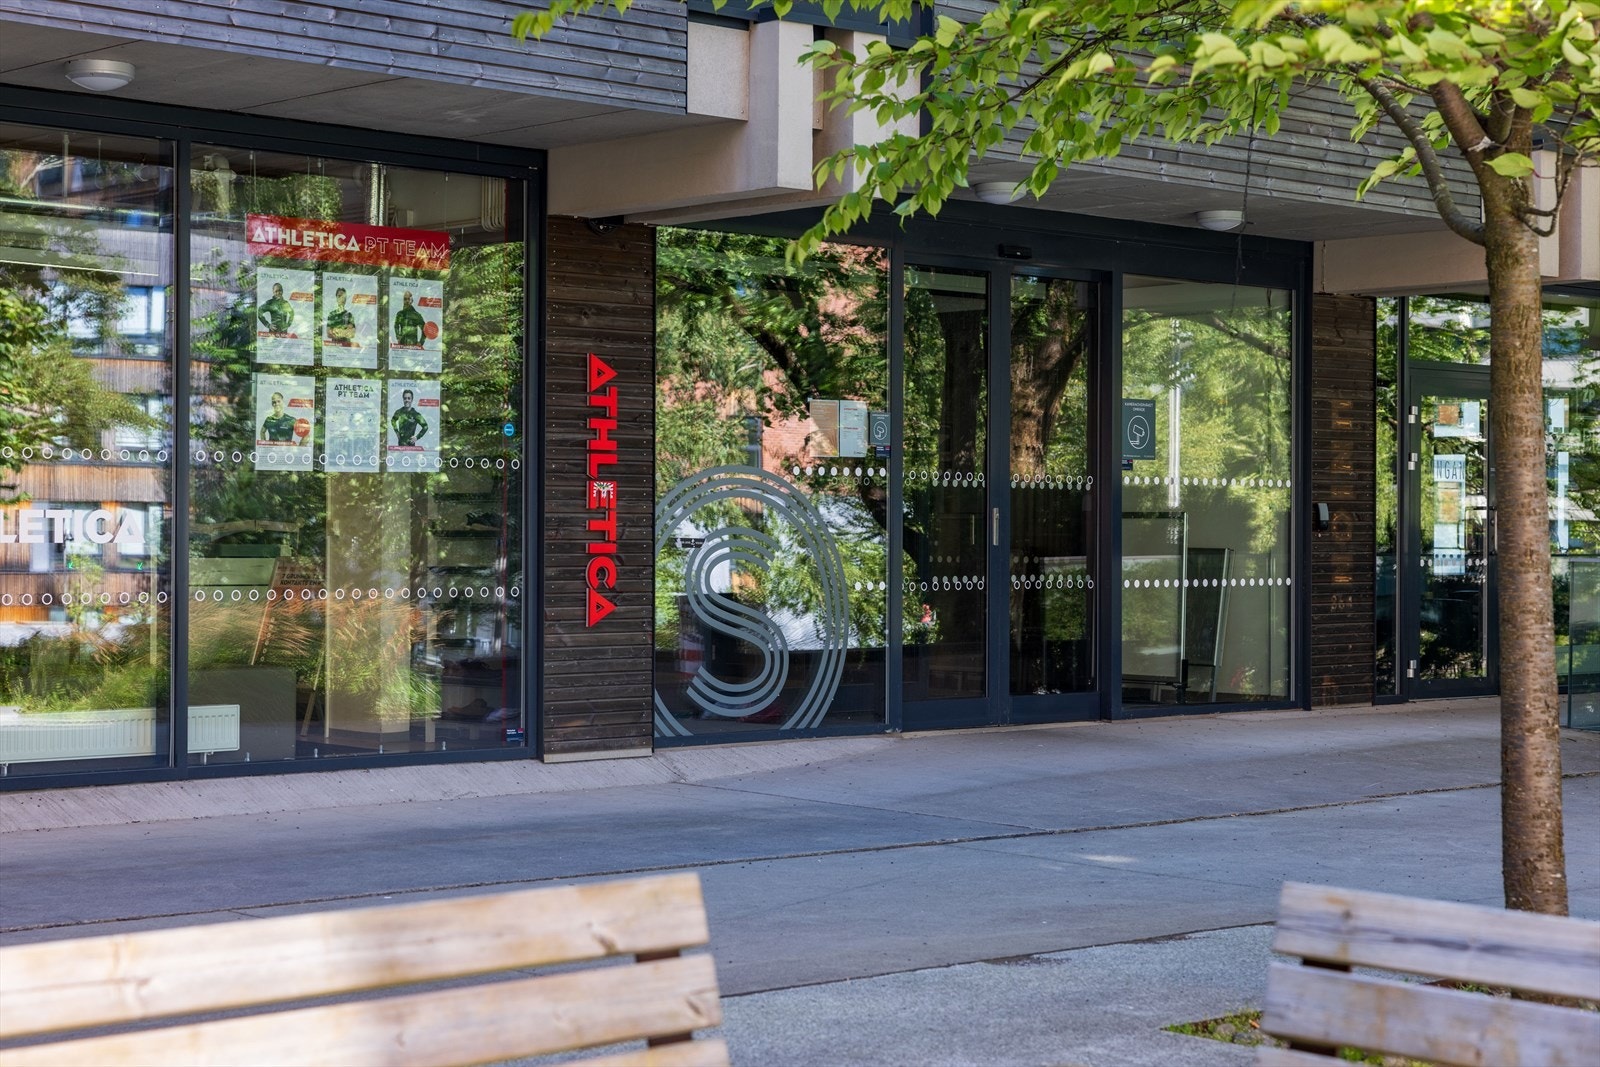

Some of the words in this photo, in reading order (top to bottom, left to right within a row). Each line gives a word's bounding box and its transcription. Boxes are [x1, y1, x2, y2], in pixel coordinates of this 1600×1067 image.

[252, 227, 360, 251] ATHLETICA
[365, 236, 389, 253] PT
[393, 239, 449, 259] TEAM
[334, 384, 374, 393] ATHLETICA
[338, 390, 347, 398] PT
[349, 391, 370, 399] TEAM
[586, 352, 618, 627] ATHLETICA
